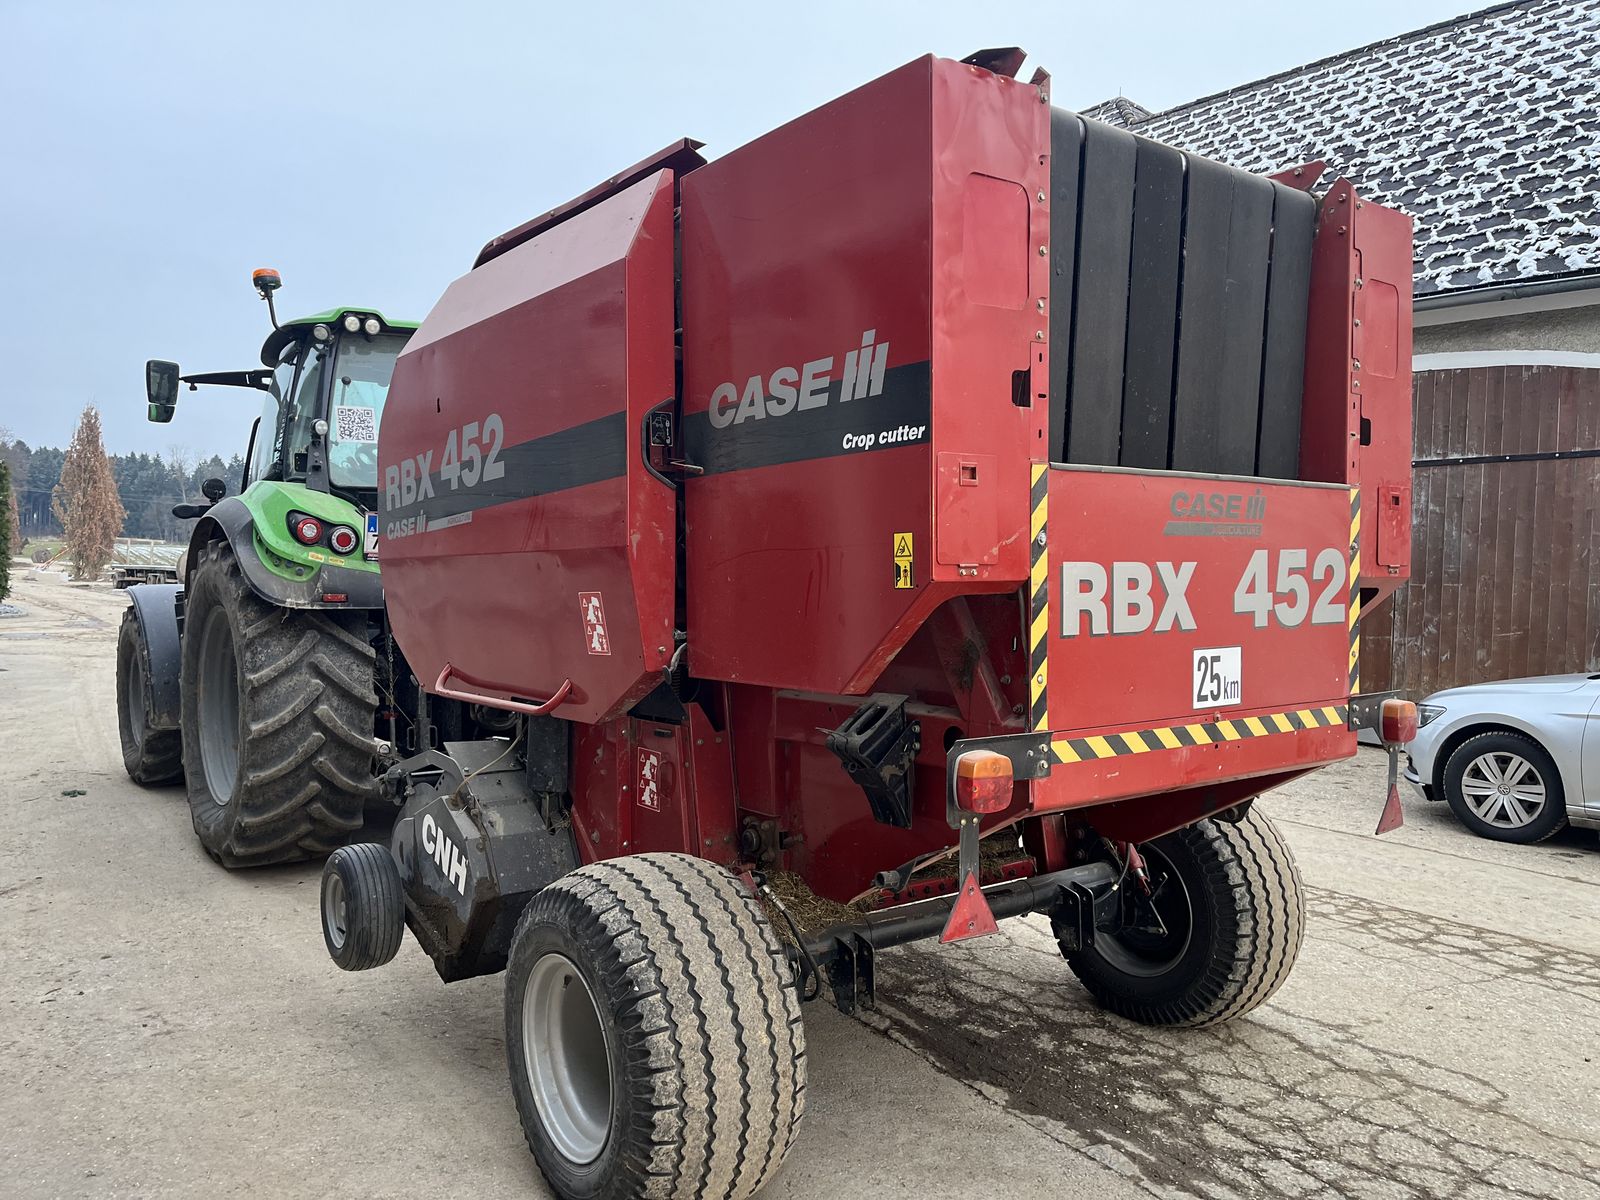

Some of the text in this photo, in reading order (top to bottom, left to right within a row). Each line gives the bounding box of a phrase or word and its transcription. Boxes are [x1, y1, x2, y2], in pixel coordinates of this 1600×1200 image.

[709, 356, 833, 429] CASE
[385, 413, 504, 511] RBX 452
[842, 424, 925, 450] Crop cutter
[387, 518, 415, 541] CASE
[1170, 491, 1242, 519] CASE
[1061, 548, 1346, 638] RBX 452
[1196, 656, 1239, 702] 25 km
[422, 813, 468, 896] CNH
